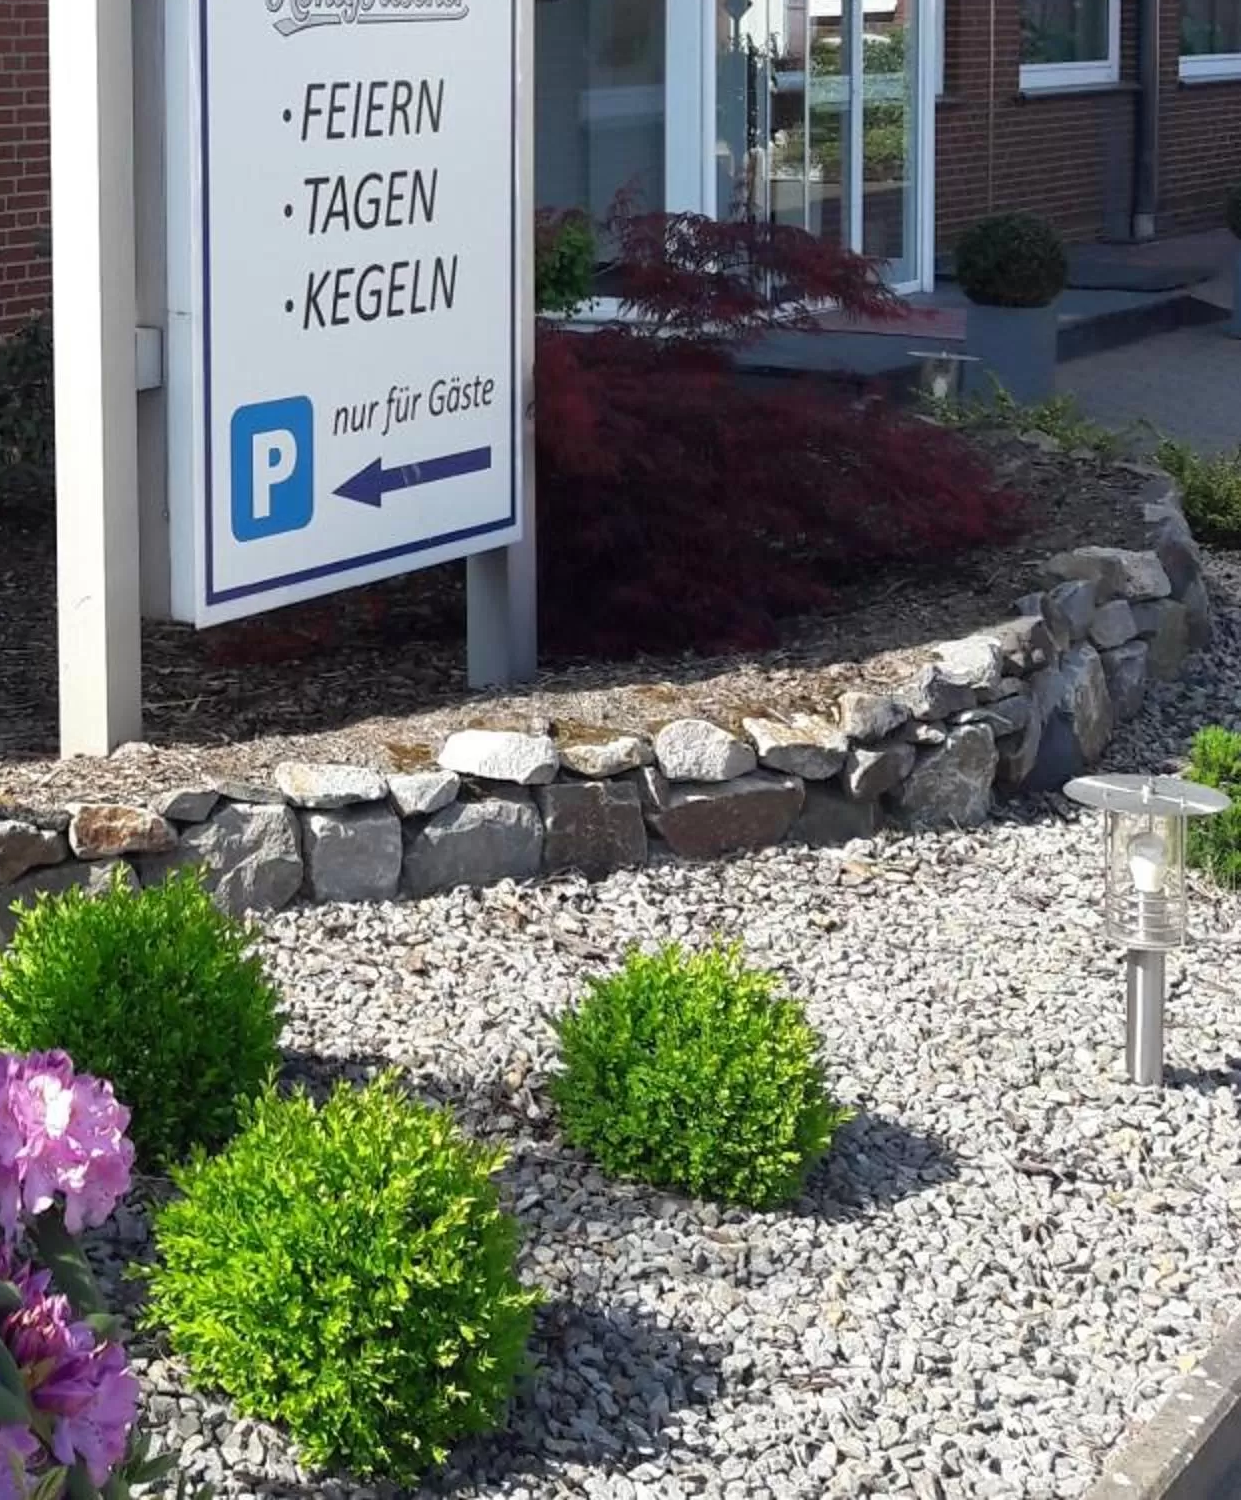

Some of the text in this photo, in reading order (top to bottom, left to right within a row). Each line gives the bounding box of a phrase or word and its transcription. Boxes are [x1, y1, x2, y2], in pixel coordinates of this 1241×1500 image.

[300, 78, 445, 142] FEIERN
[304, 167, 439, 235] TAGEN
[302, 254, 458, 331] KEGELN
[332, 375, 495, 437] nur für Gäste
[251, 428, 299, 520] P
